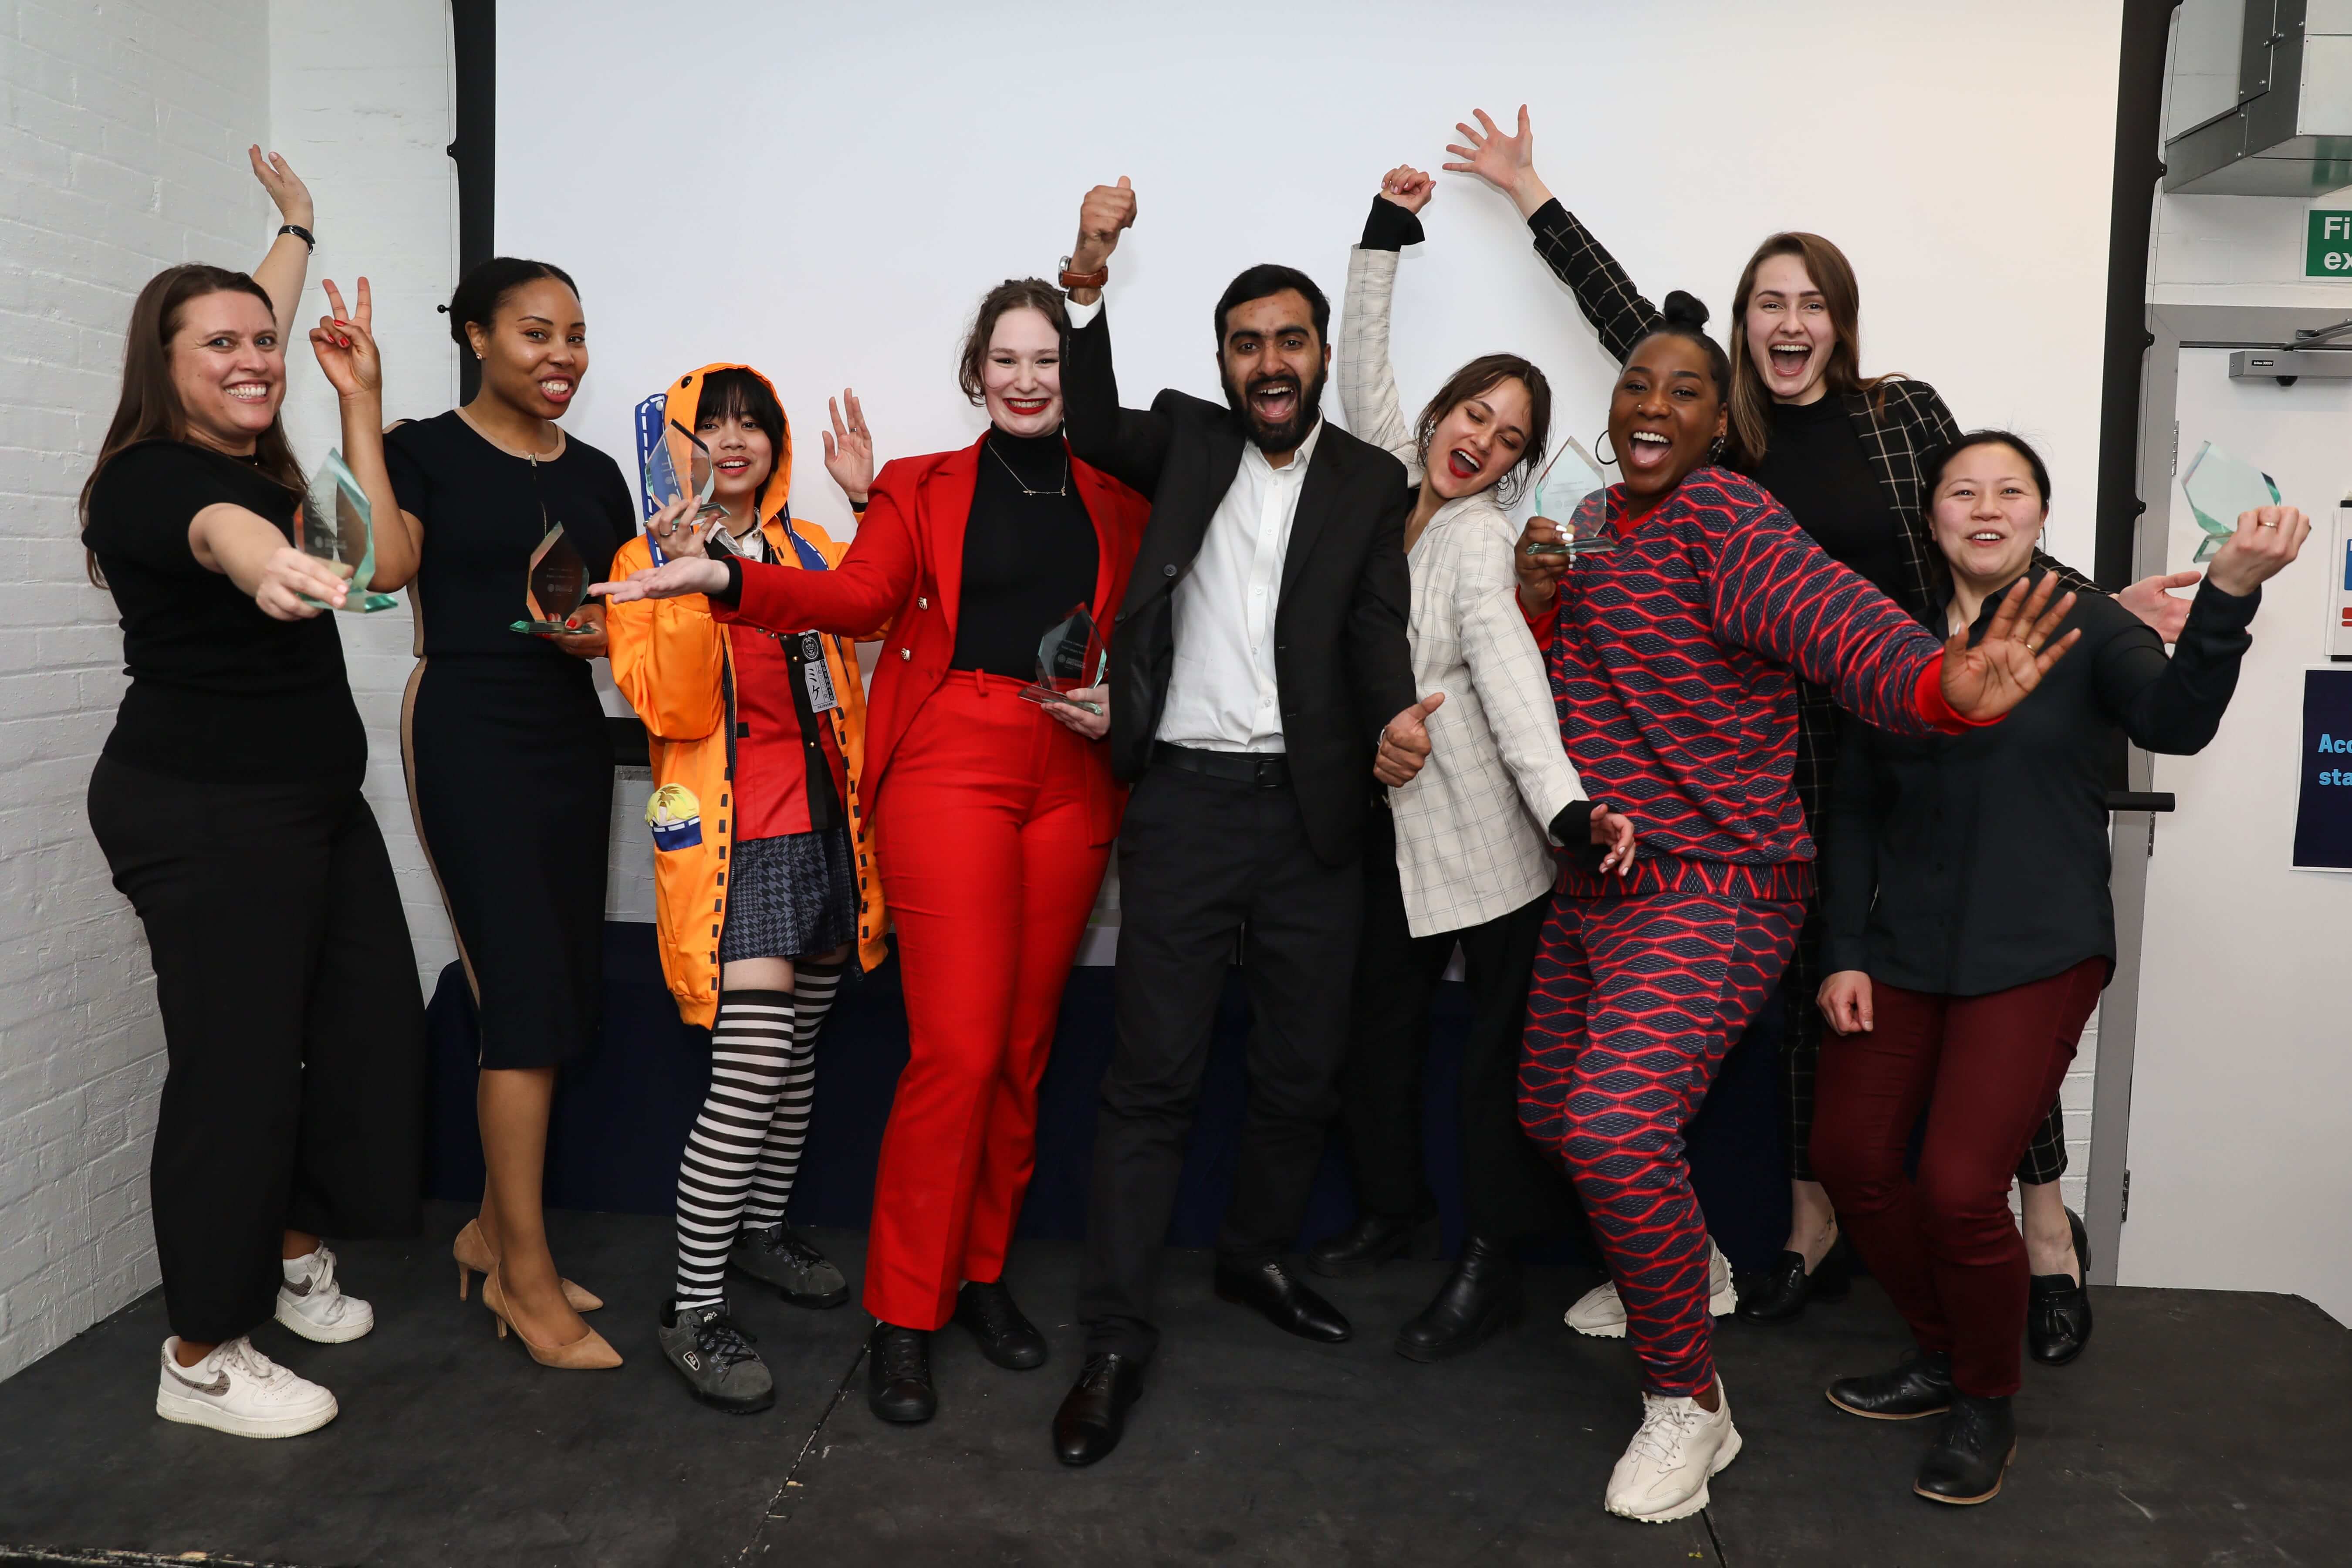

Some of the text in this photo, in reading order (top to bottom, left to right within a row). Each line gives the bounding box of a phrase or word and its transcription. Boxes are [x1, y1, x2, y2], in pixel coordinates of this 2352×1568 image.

[2324, 216, 2350, 240] Fi
[2324, 252, 2352, 270] ex
[808, 668, 820, 701] ミケ
[2319, 769, 2352, 786] sta
[703, 1311, 718, 1323] FILA
